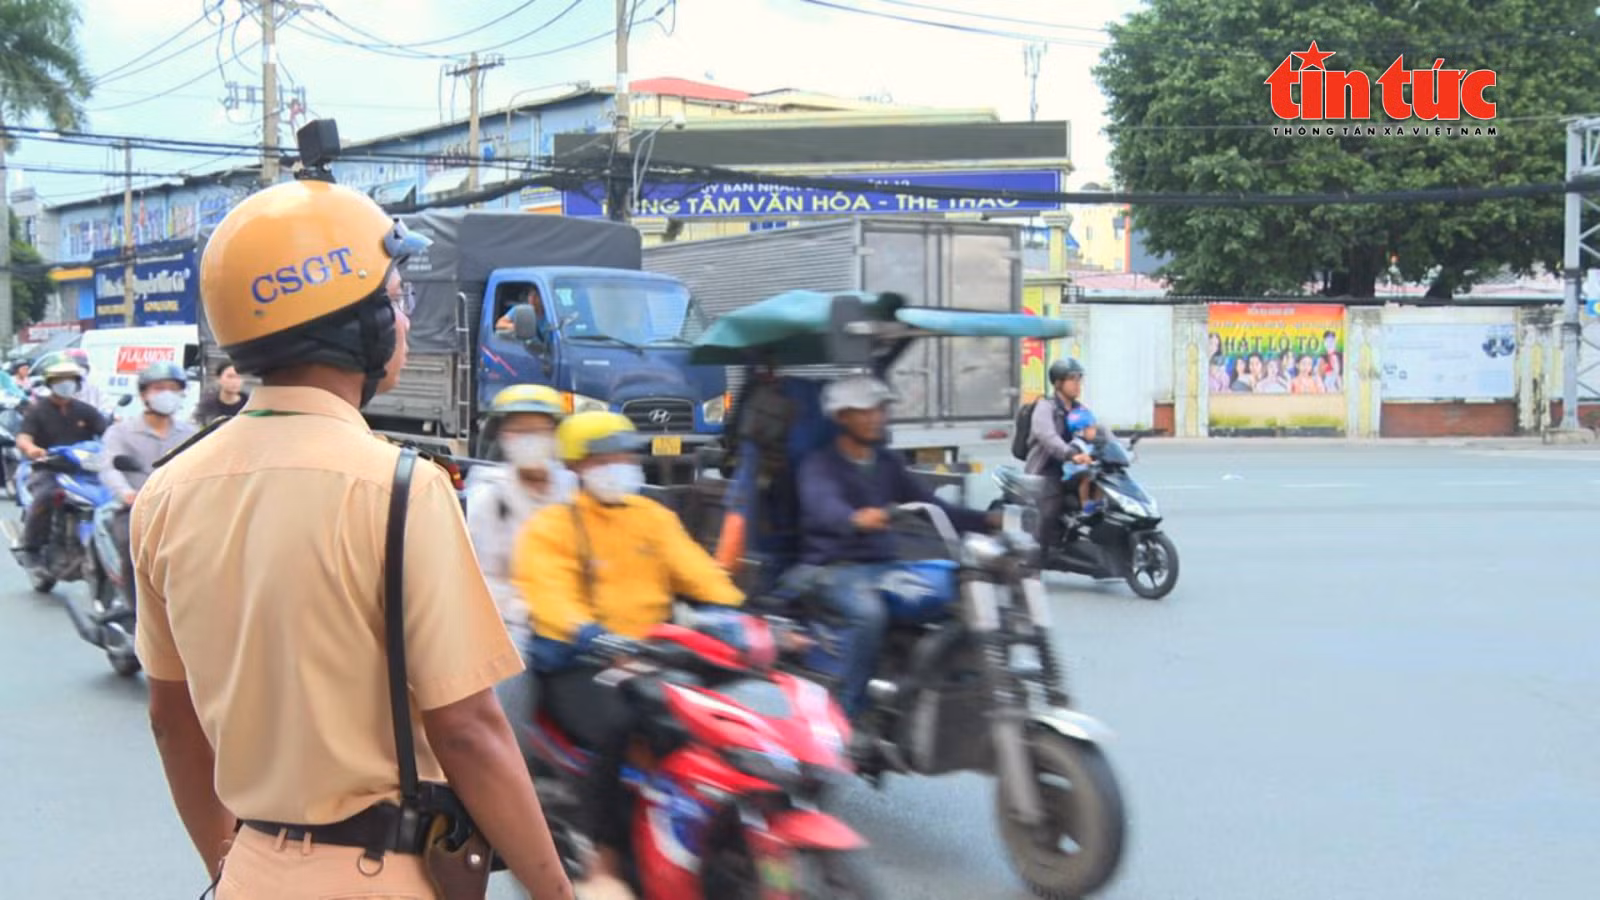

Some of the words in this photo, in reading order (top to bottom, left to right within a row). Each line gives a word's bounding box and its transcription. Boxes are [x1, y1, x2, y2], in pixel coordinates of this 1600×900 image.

[723, 183, 754, 193] BAN
[686, 194, 740, 214] TÂM
[747, 192, 803, 212] VĂN
[812, 191, 871, 211] HÓA
[251, 246, 353, 304] CSGT
